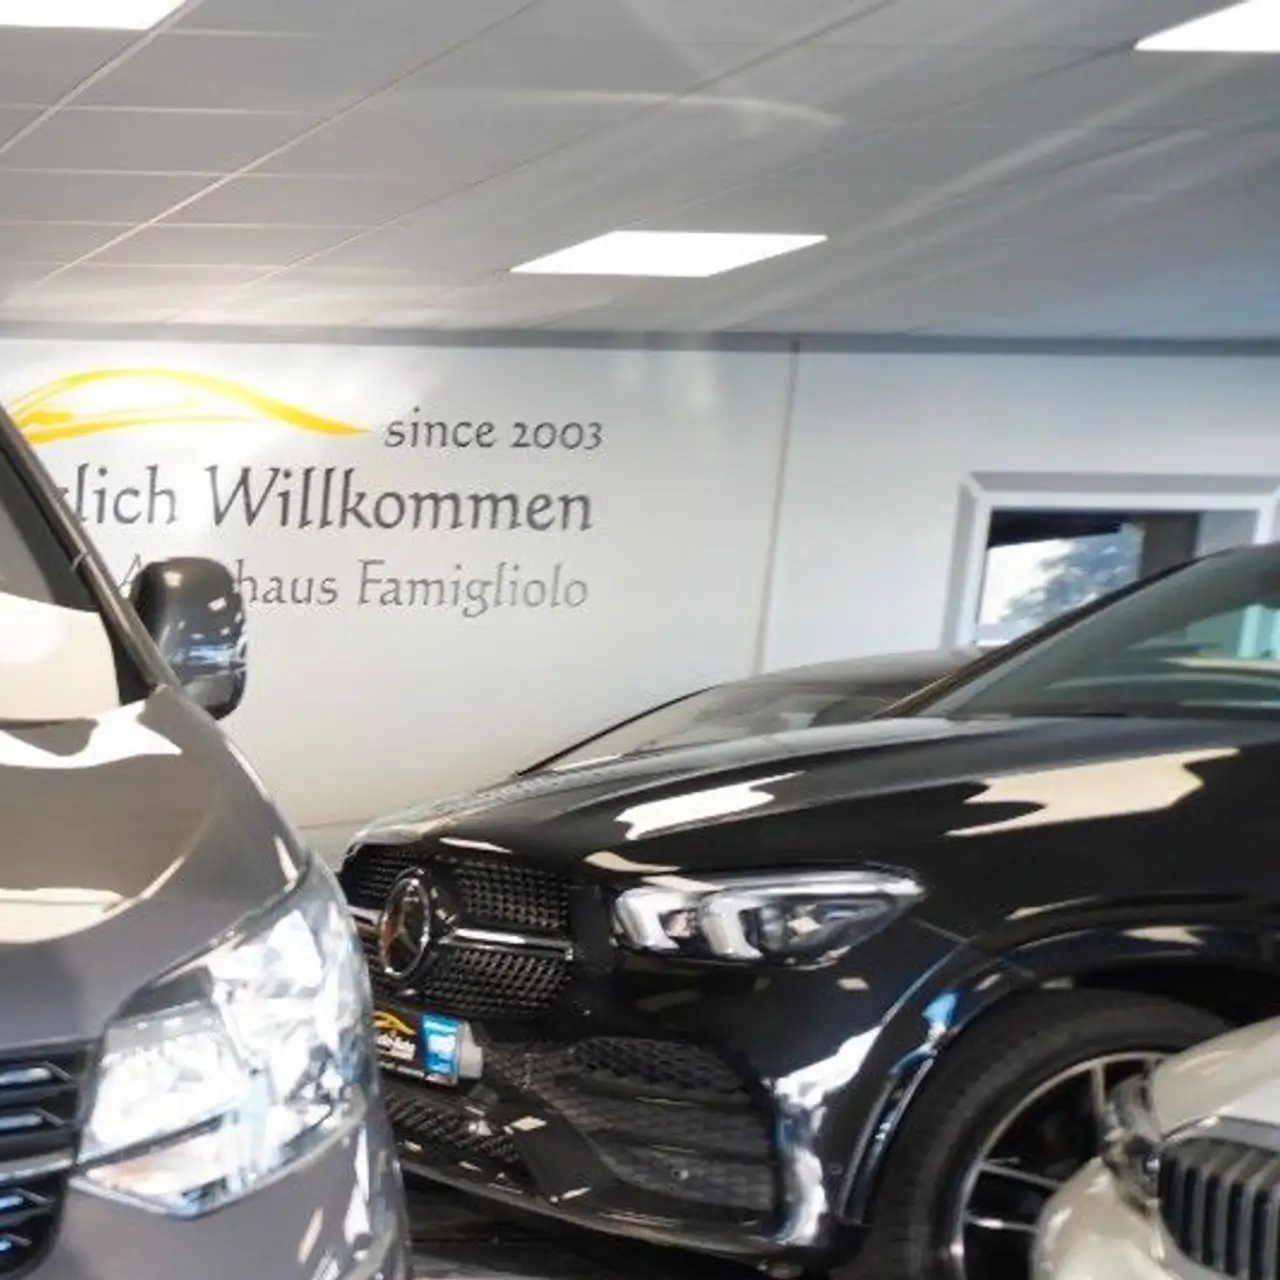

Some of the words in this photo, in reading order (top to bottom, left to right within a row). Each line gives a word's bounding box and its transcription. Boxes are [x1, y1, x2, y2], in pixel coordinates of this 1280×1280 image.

[384, 405, 497, 449] since
[509, 421, 603, 450] 2003
[205, 463, 594, 533] Willkommen
[357, 557, 589, 618] Famigliolo
